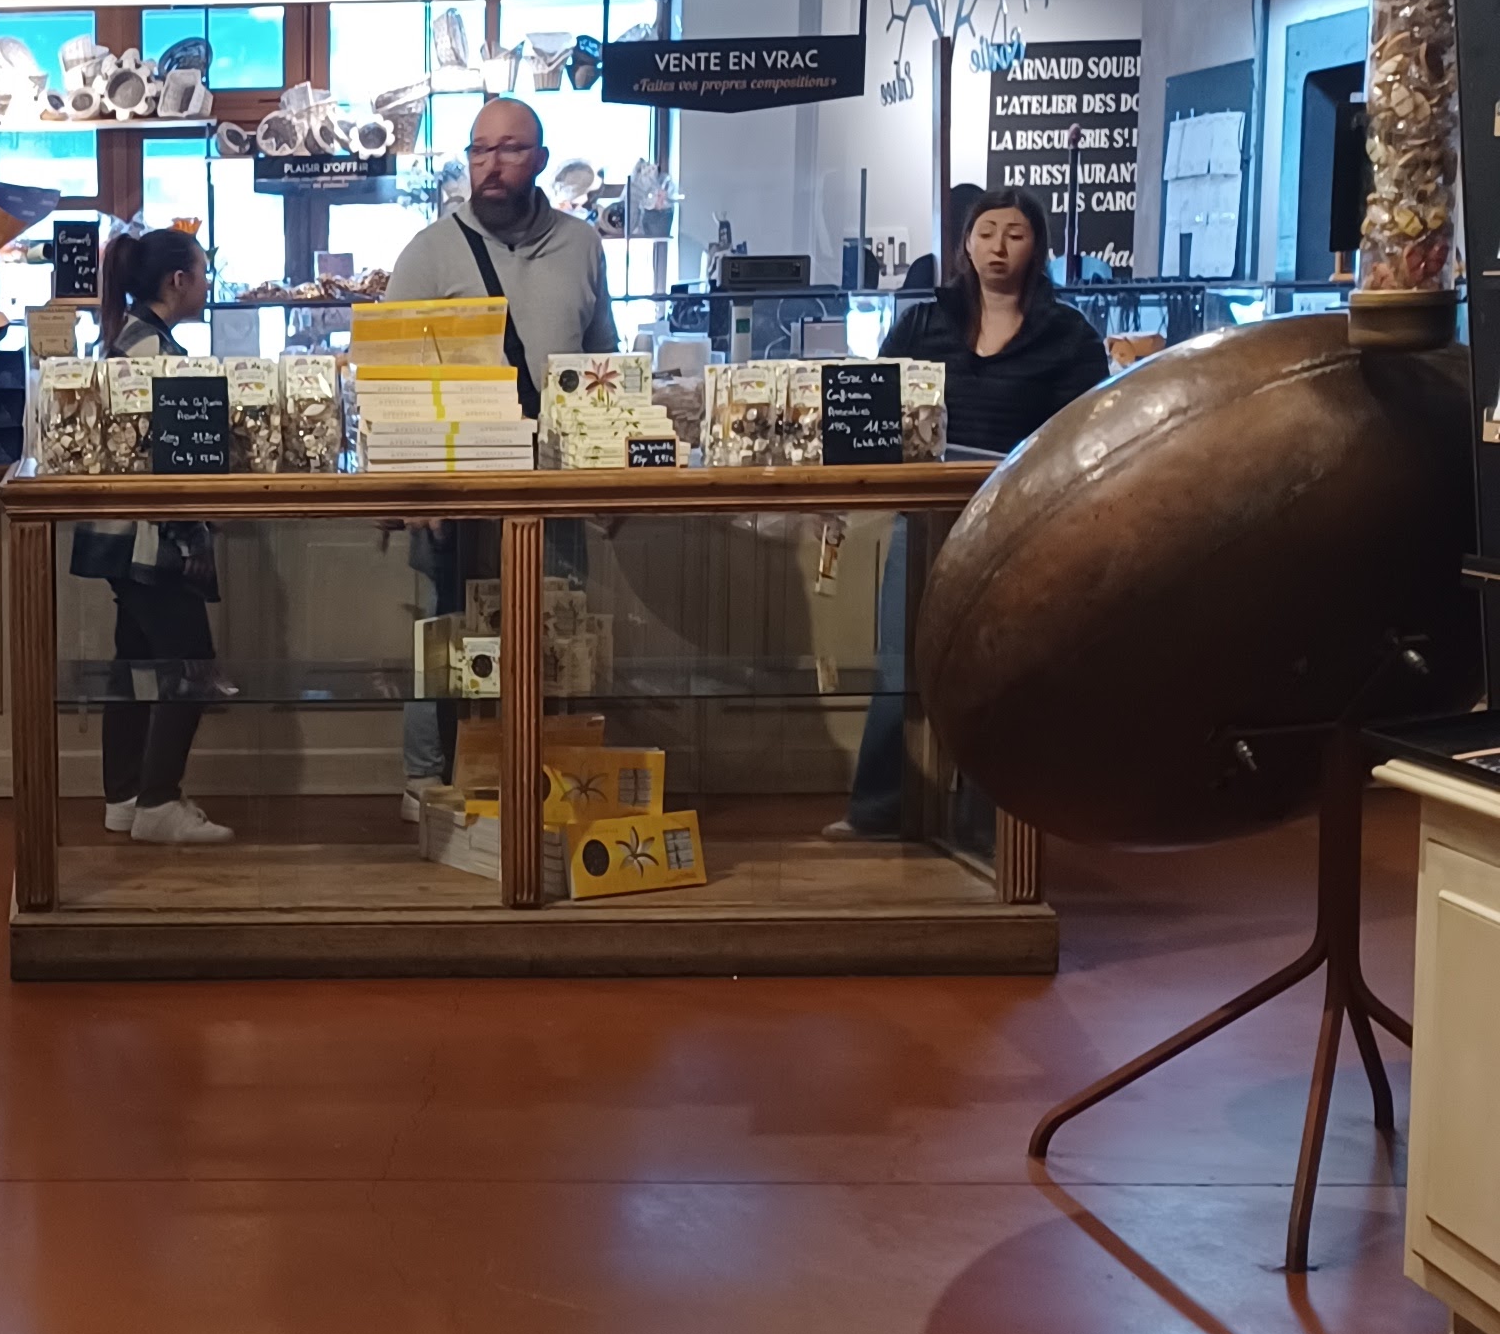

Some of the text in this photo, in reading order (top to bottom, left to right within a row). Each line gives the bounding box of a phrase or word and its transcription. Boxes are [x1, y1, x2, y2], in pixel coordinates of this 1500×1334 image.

[654, 49, 819, 73] VENTE EN VRAC
[1006, 57, 1084, 82] ARNAUD
[678, 78, 698, 92] vos
[700, 77, 748, 97] propres
[995, 93, 1078, 117] L'ATELIER
[1081, 93, 1117, 114] DES
[991, 130, 1014, 151] LA
[1015, 128, 1110, 151] BISCUIERIE
[283, 163, 321, 175] PLAISIR
[1003, 165, 1026, 187] LE
